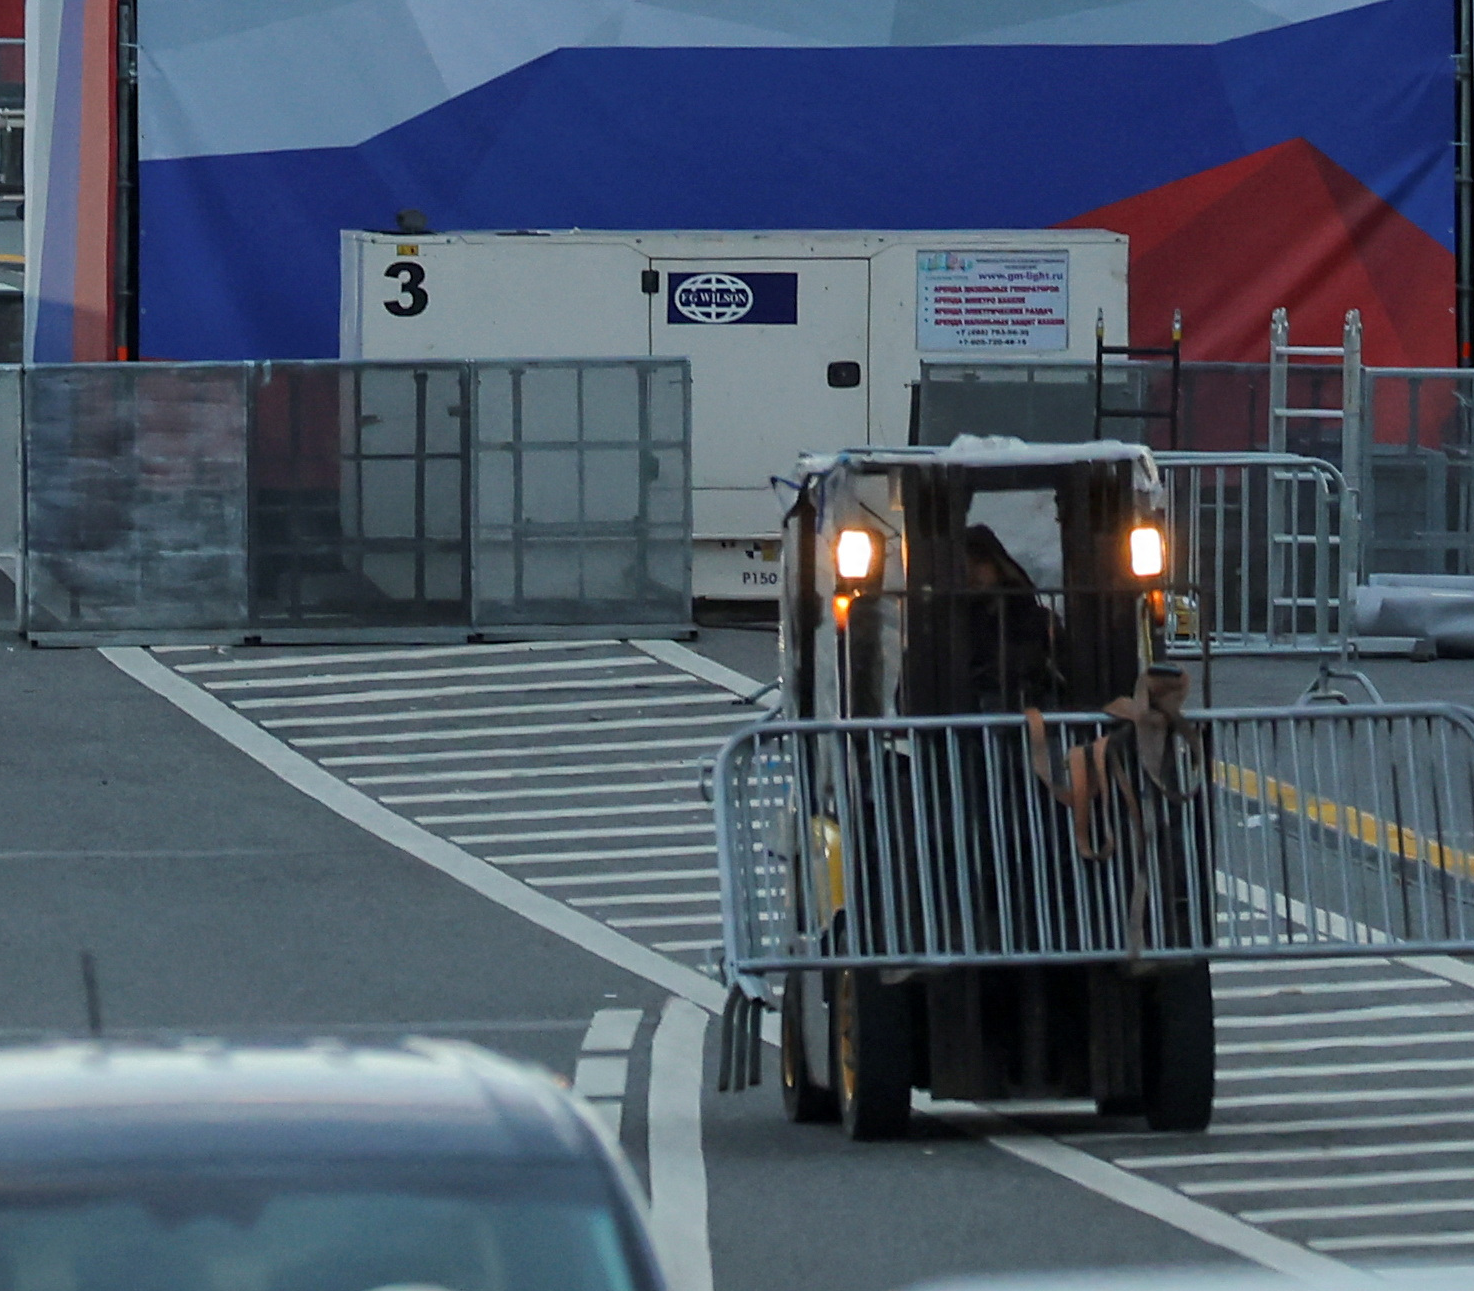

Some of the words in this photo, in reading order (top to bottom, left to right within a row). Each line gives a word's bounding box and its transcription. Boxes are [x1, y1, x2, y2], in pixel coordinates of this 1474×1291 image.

[383, 261, 429, 318] 3
[699, 291, 748, 304] WILSON
[742, 571, 778, 585] P150
